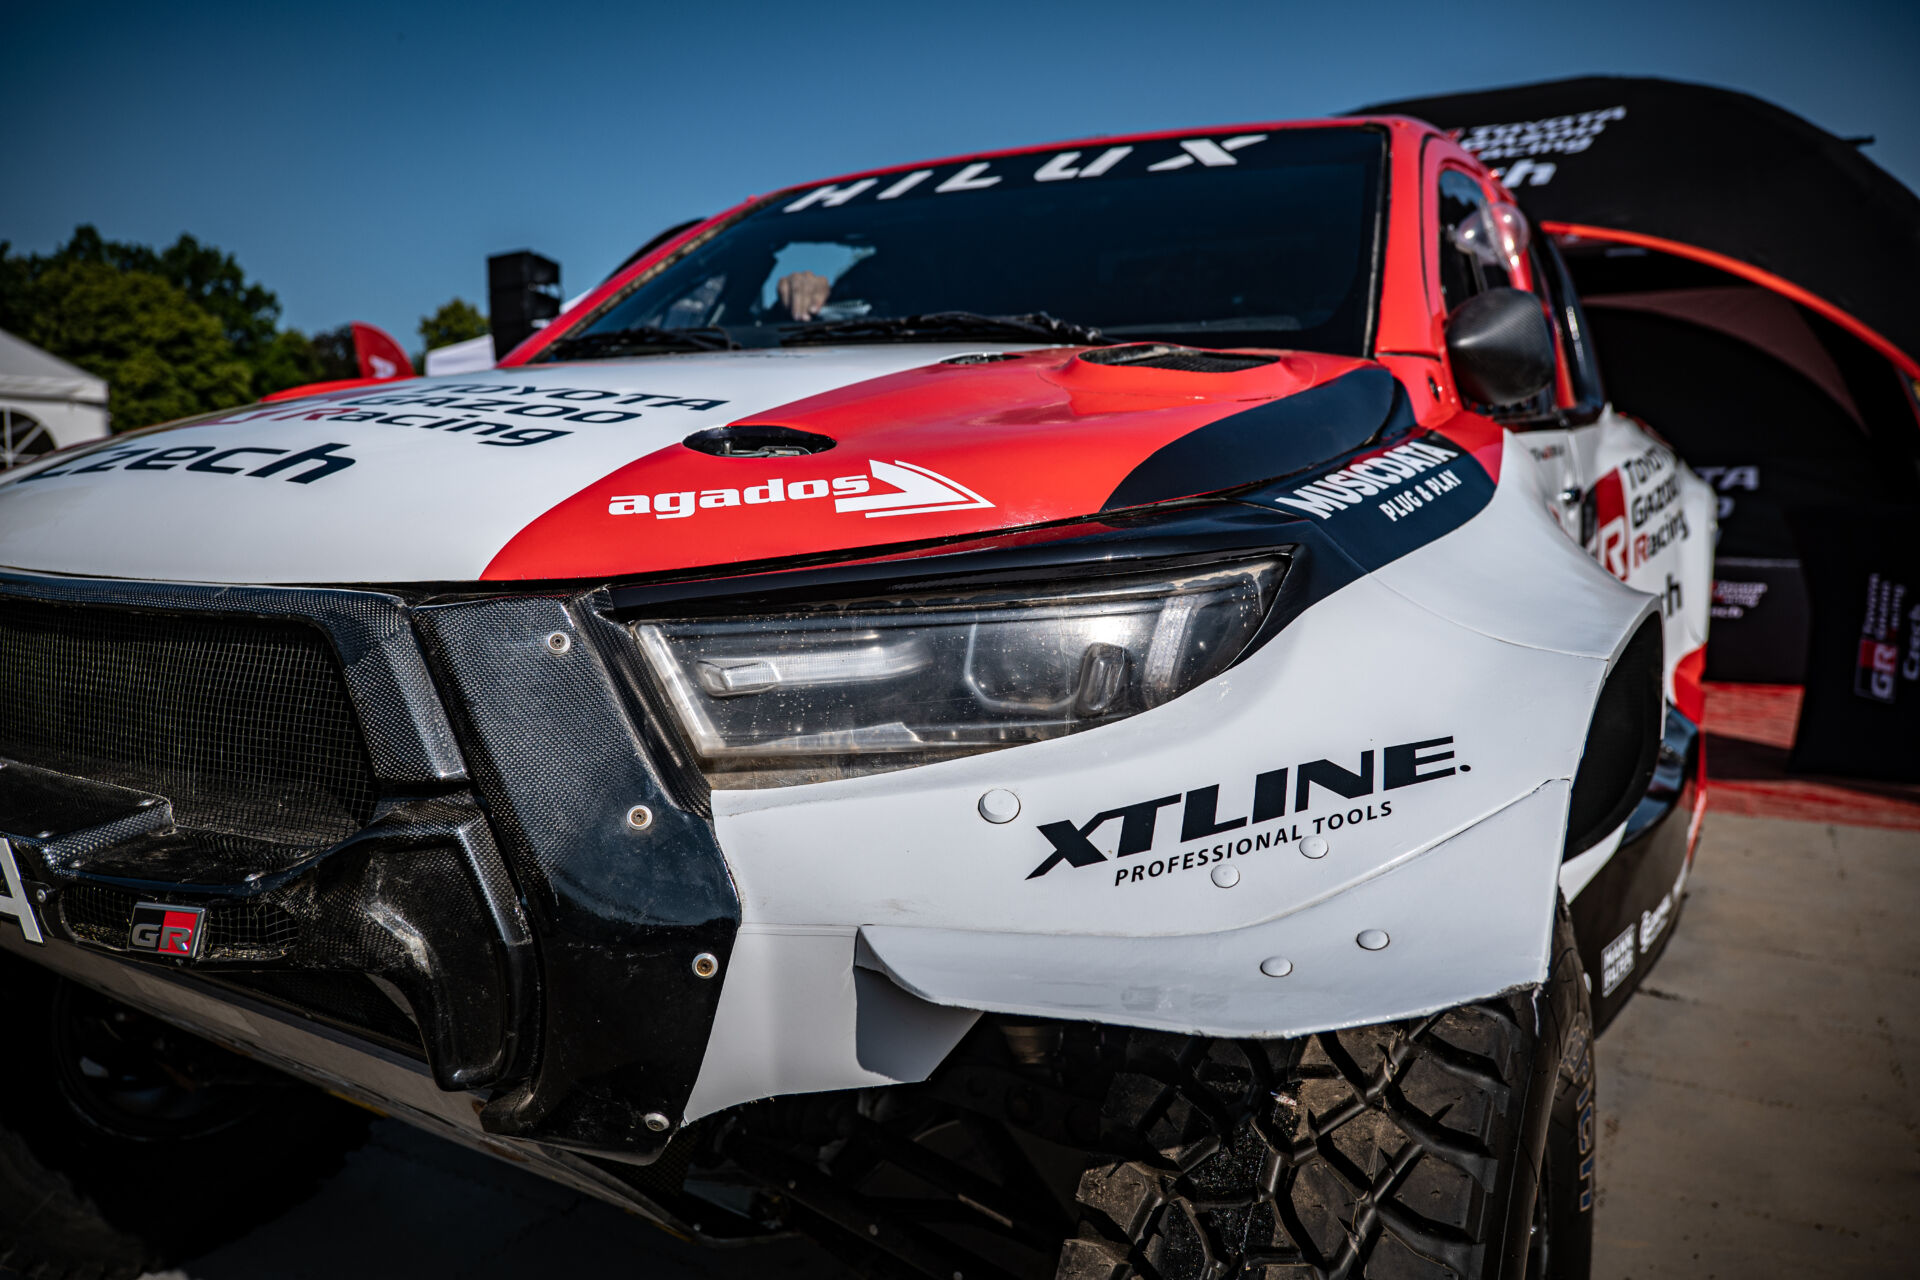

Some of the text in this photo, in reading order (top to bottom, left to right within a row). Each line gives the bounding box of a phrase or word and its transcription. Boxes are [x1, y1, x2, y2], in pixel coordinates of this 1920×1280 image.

[783, 133, 1269, 214] HILUX
[338, 394, 643, 424] GAZOO
[413, 383, 732, 412] TOYOTA
[270, 406, 575, 447] Racing
[608, 474, 870, 520] agados
[1274, 441, 1459, 520] MUSICDATA
[1378, 469, 1462, 522] PLUG & PLAY
[1114, 800, 1393, 887] PROFESSIONAL TOOLS
[132, 922, 191, 952] GR
